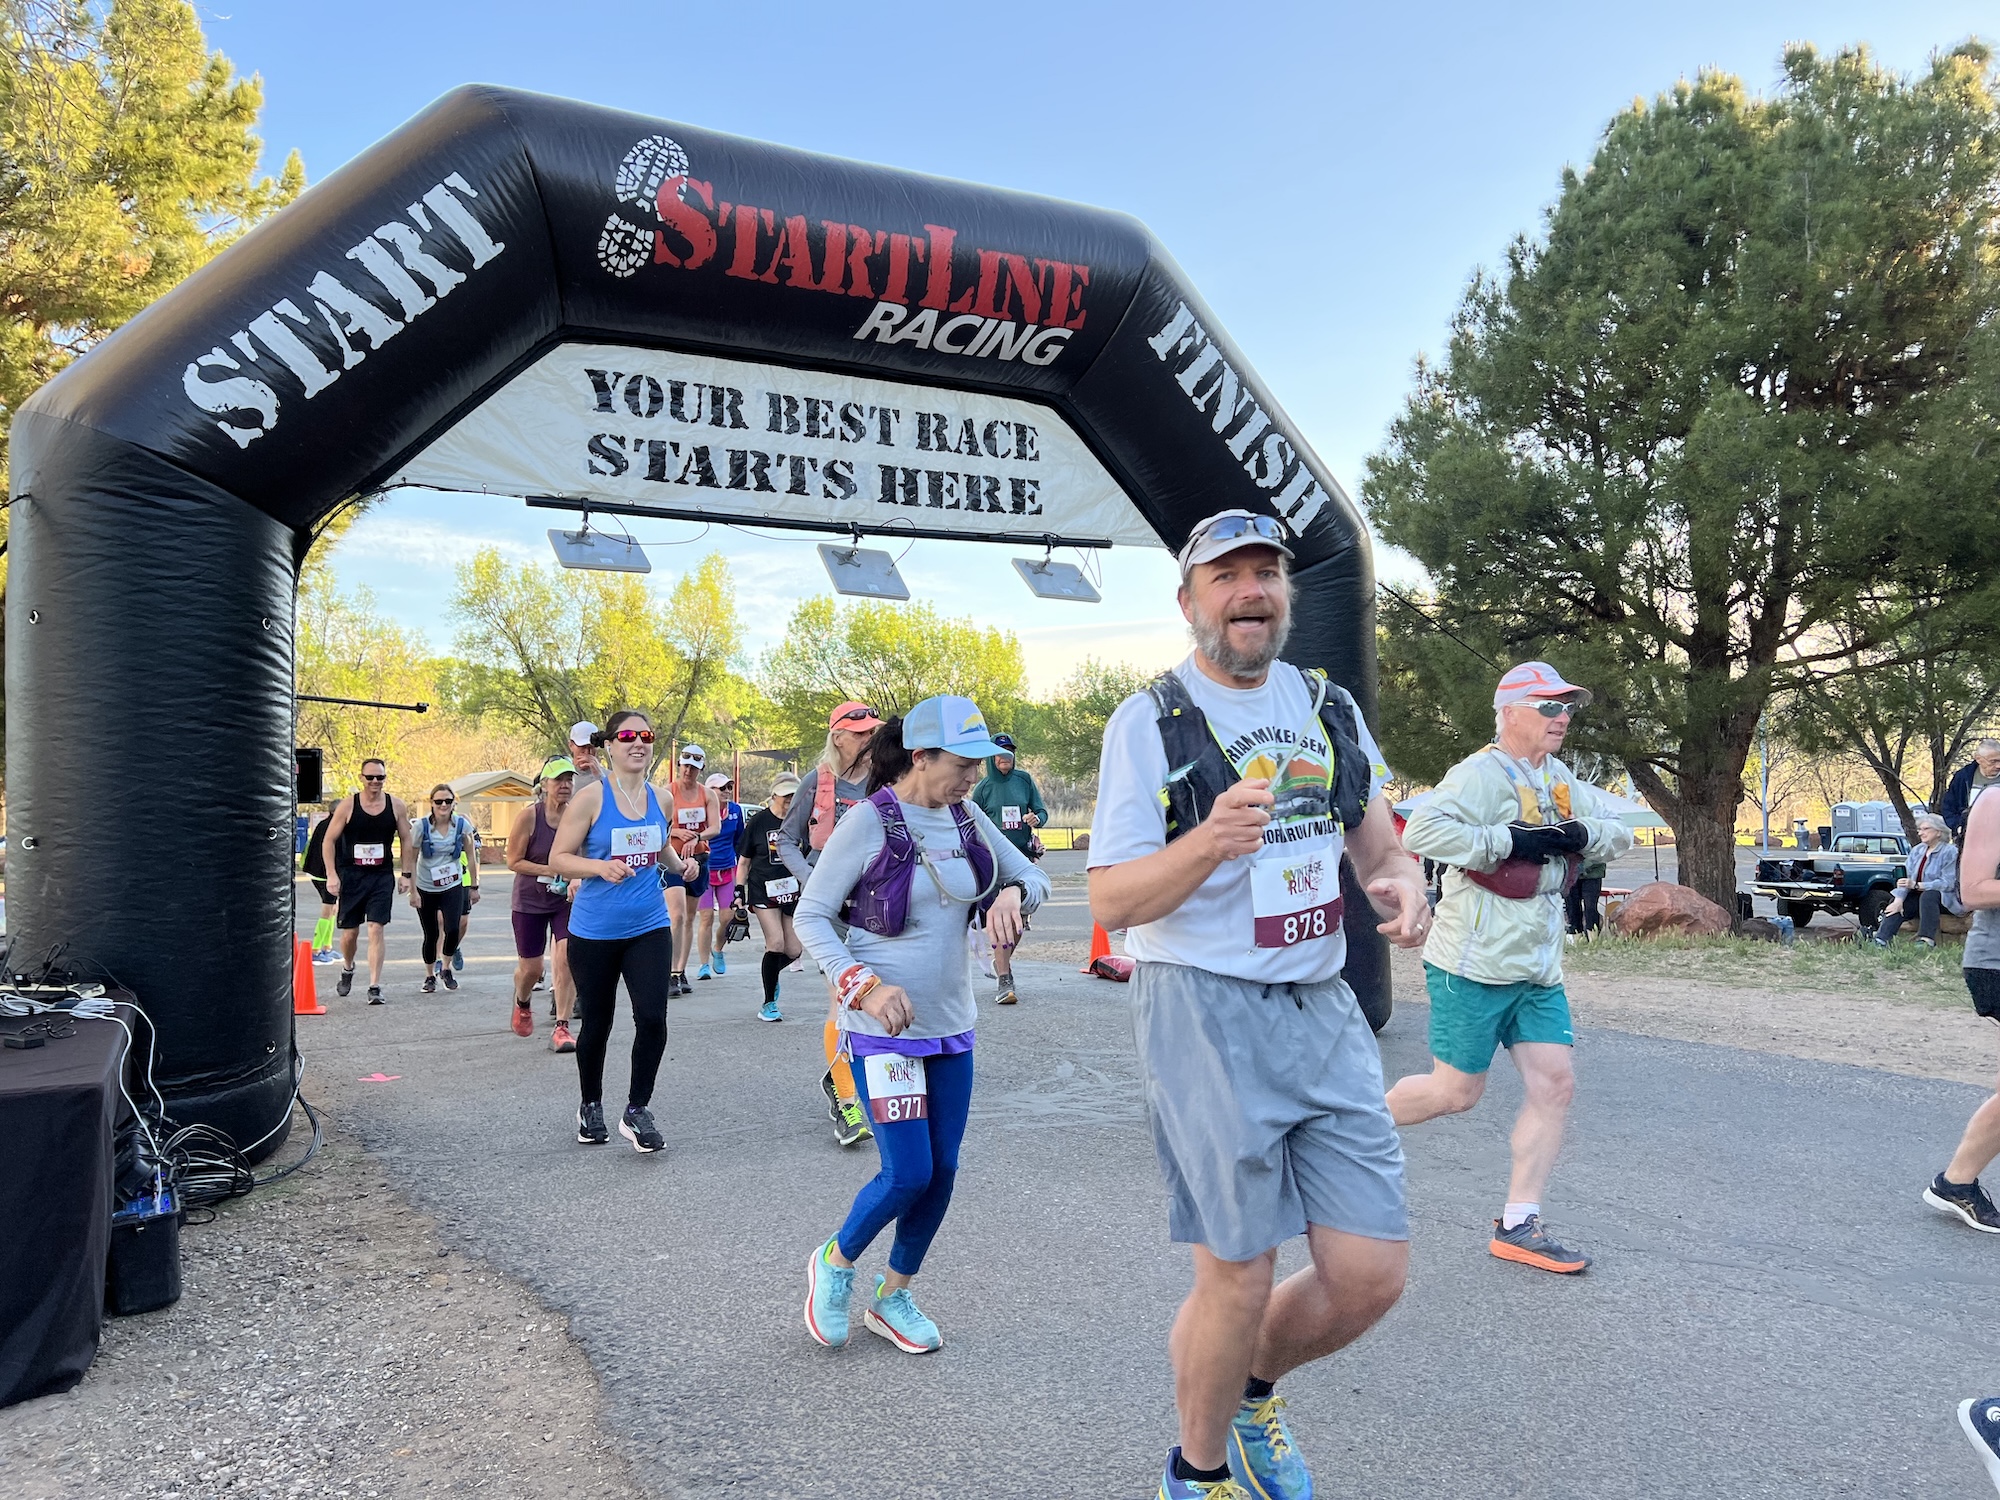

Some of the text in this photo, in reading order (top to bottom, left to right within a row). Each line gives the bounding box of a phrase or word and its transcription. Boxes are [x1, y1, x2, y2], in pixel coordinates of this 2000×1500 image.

[182, 170, 505, 450] START
[853, 302, 1074, 366] RACING
[584, 368, 1040, 462] YOUR BEST RACE
[1147, 300, 1330, 538] FINISH
[587, 432, 1044, 516] STARTS HERE
[626, 854, 649, 867] 805
[1290, 860, 1324, 880] VINTAGE
[776, 893, 793, 904] 902
[1289, 874, 1318, 895] RUN
[1283, 908, 1327, 944] 878
[890, 1069, 914, 1082] RUN
[887, 1097, 921, 1120] 877
